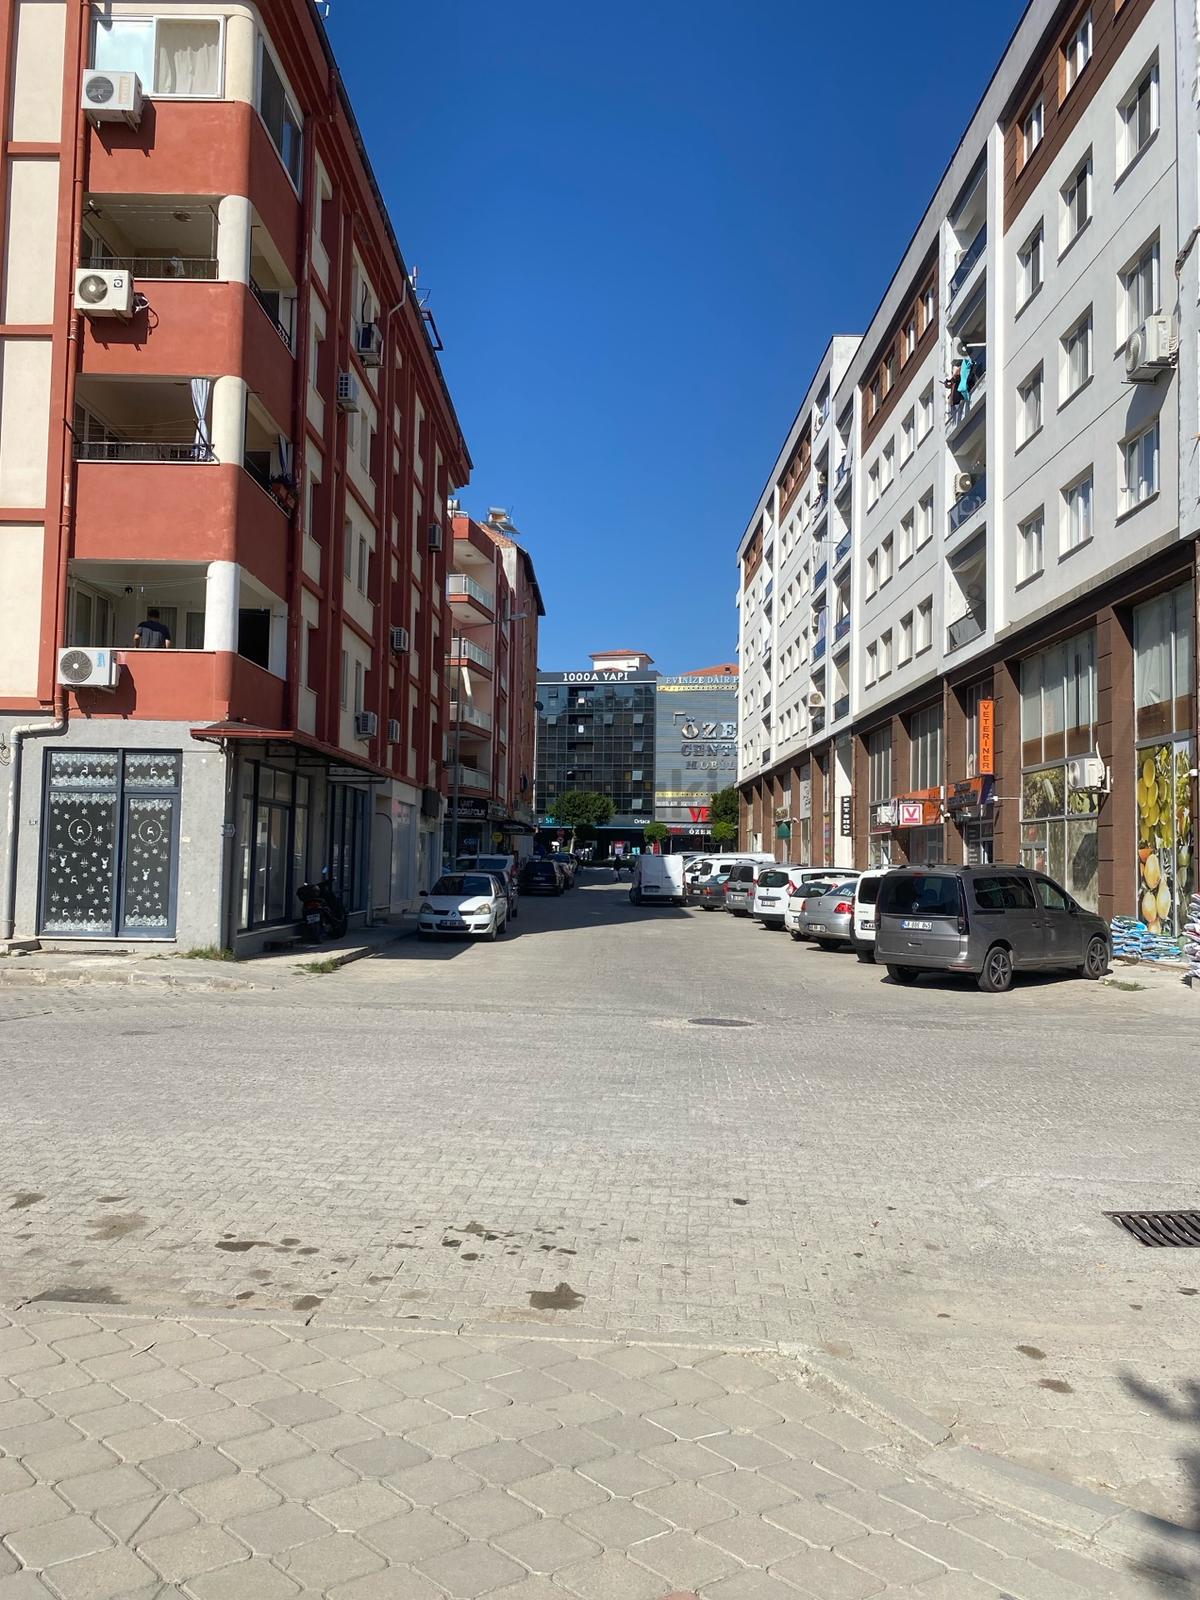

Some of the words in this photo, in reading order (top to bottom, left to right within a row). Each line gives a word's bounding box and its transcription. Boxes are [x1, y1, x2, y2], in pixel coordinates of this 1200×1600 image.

[563, 672, 599, 682] 1000A
[603, 672, 629, 681] YAPI
[681, 716, 738, 740] ÖZE
[681, 743, 738, 757] CENT
[688, 827, 712, 835] ÖZER
